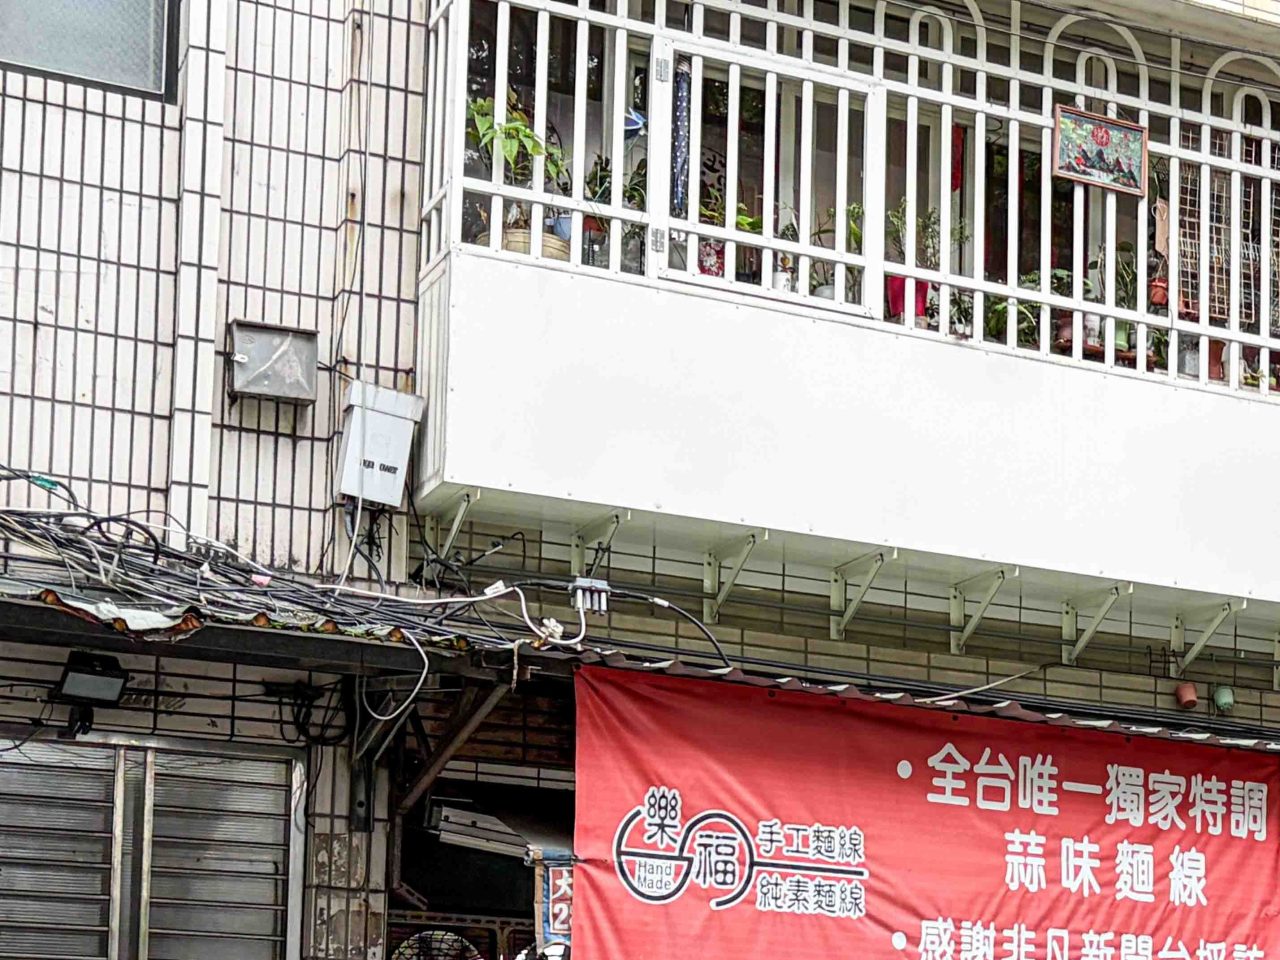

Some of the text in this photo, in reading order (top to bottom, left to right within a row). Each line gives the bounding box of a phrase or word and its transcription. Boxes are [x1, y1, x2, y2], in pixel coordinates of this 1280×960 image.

[926, 741, 1268, 843] 全台唯一獨家特調
[646, 785, 740, 888] 樂福
[758, 820, 864, 862] 手工麵線
[637, 876, 672, 891] Made
[638, 861, 672, 875] Hand
[1004, 829, 1208, 908] 蒜味麵線
[553, 904, 572, 930] 2
[757, 877, 865, 917] 純素麵線
